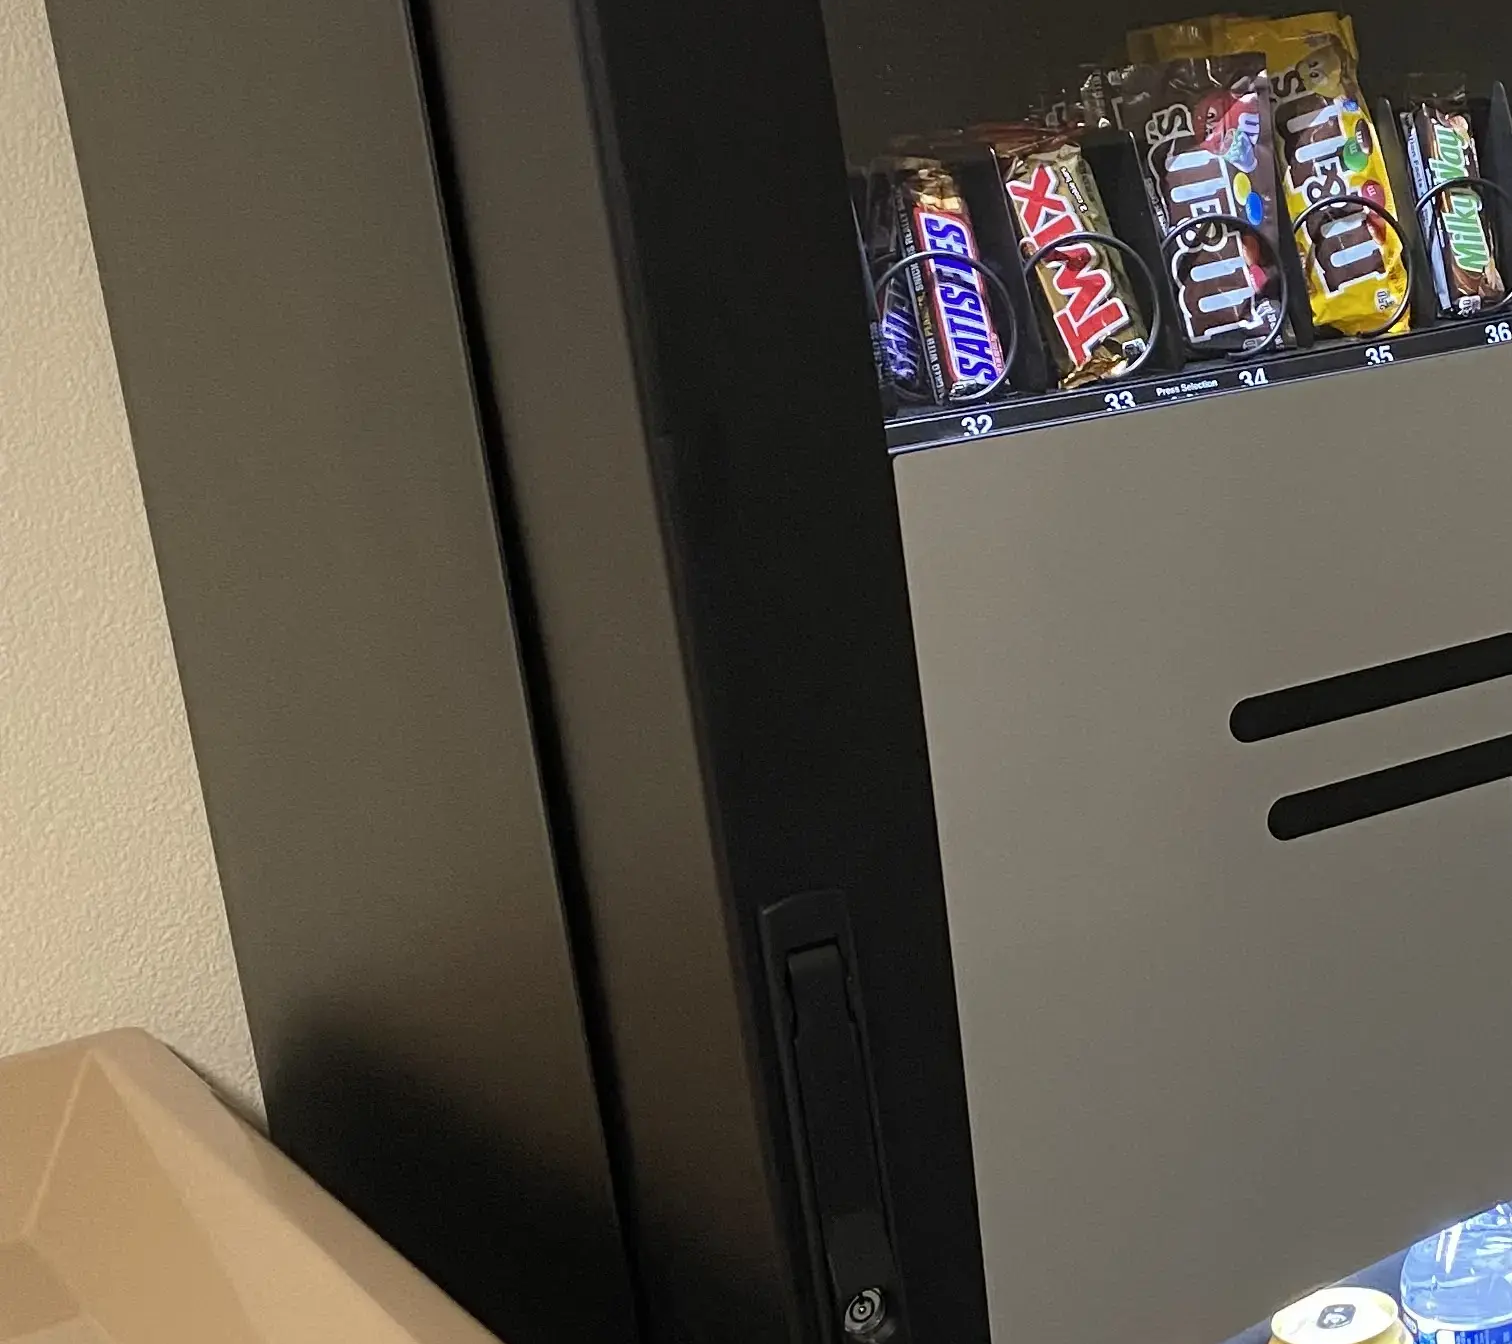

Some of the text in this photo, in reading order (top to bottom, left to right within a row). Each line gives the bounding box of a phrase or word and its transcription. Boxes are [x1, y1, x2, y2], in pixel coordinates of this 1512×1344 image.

[1431, 124, 1469, 184] Way
[1442, 186, 1488, 272] Milky
[924, 216, 998, 385] SATISFIES
[1485, 321, 1512, 344] 36
[1365, 345, 1394, 367] 35
[1156, 378, 1218, 396] Press Selection
[1238, 367, 1268, 387] 34
[1104, 390, 1136, 412] 33
[961, 414, 993, 436] 32
